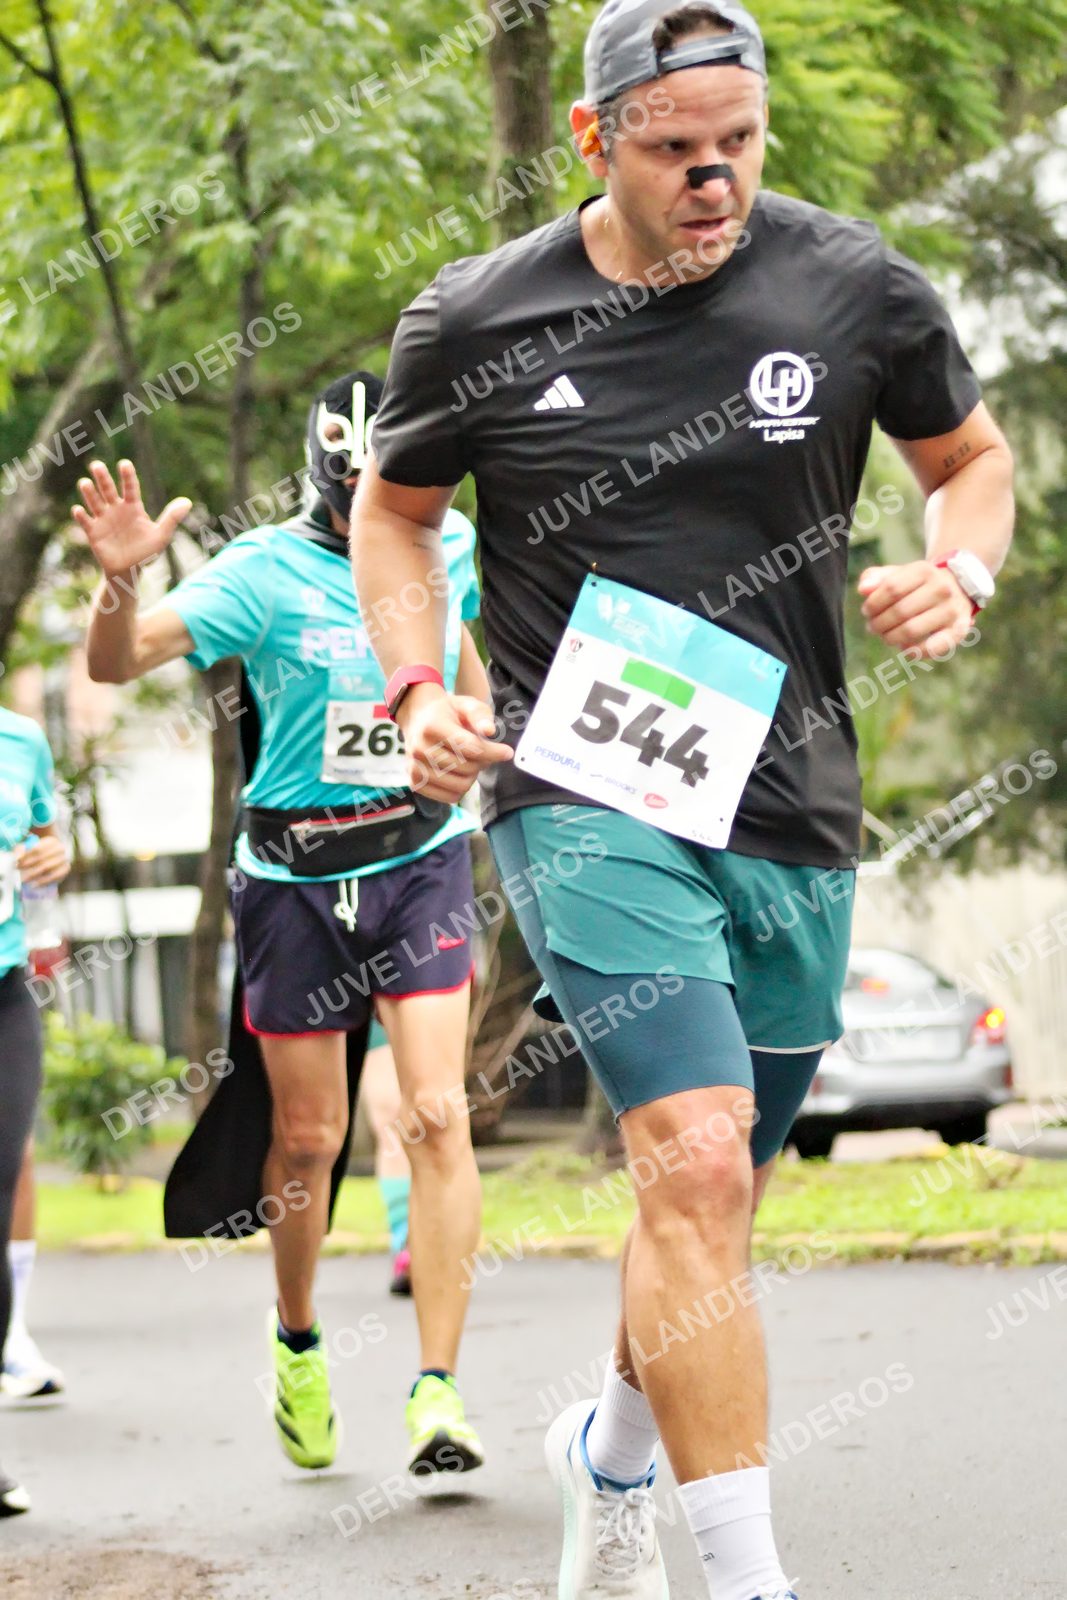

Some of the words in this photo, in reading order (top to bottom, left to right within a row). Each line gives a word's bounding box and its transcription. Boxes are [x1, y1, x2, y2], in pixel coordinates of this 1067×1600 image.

[763, 427, 805, 444] Lapisa
[570, 680, 710, 788] 544
[534, 745, 581, 772] PERDURA
